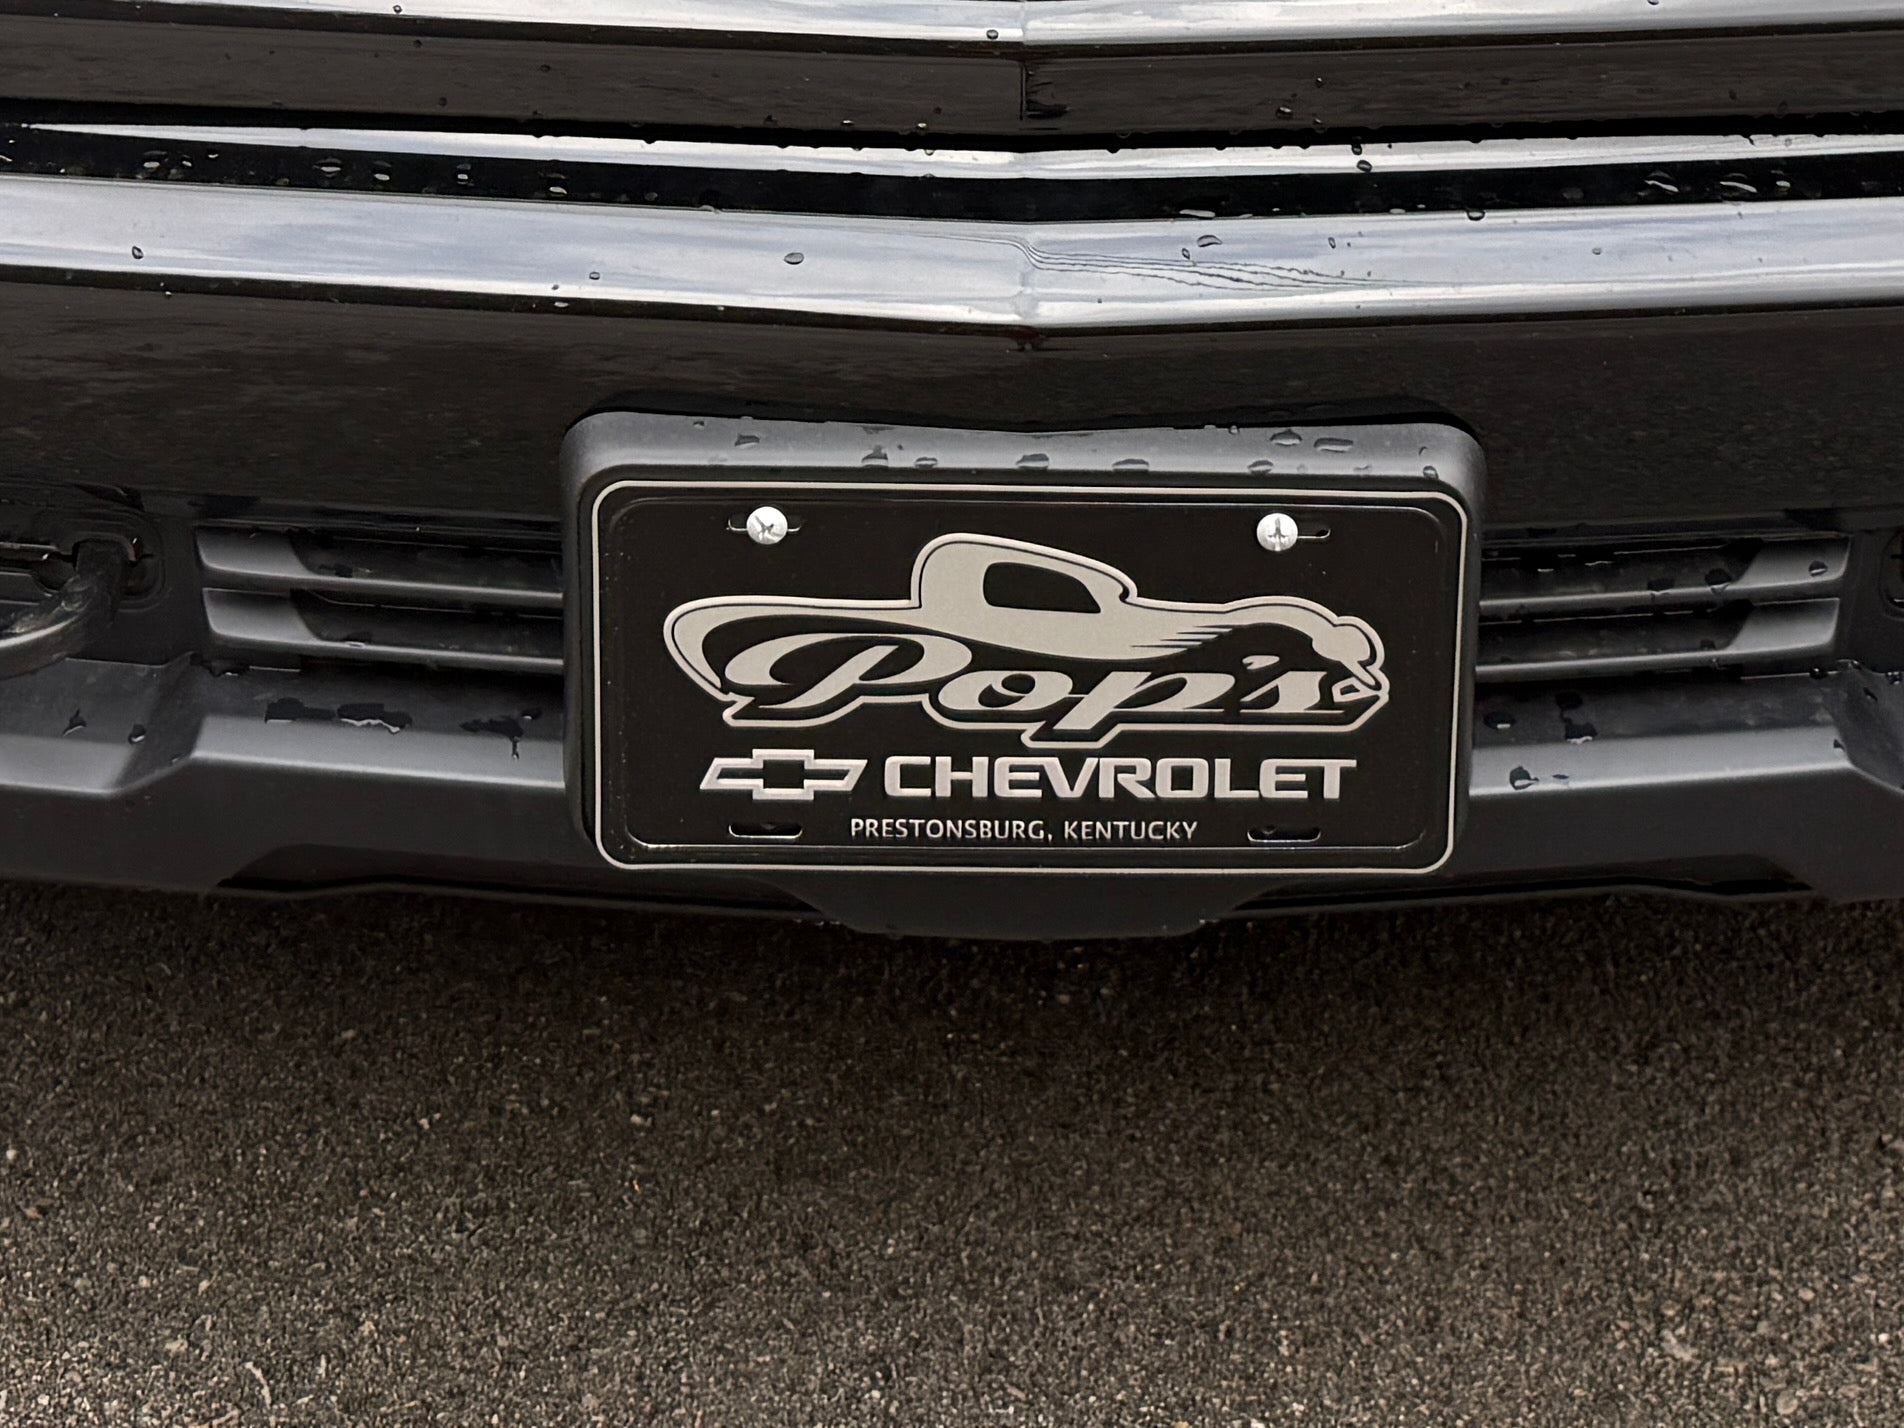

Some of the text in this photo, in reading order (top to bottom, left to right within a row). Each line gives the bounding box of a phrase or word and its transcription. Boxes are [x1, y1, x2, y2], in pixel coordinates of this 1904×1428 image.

[724, 631, 1345, 732] Pop's
[883, 755, 1358, 800] CHEVROLET
[850, 817, 1198, 843] PRESTONSBURG, KENTUCKY
